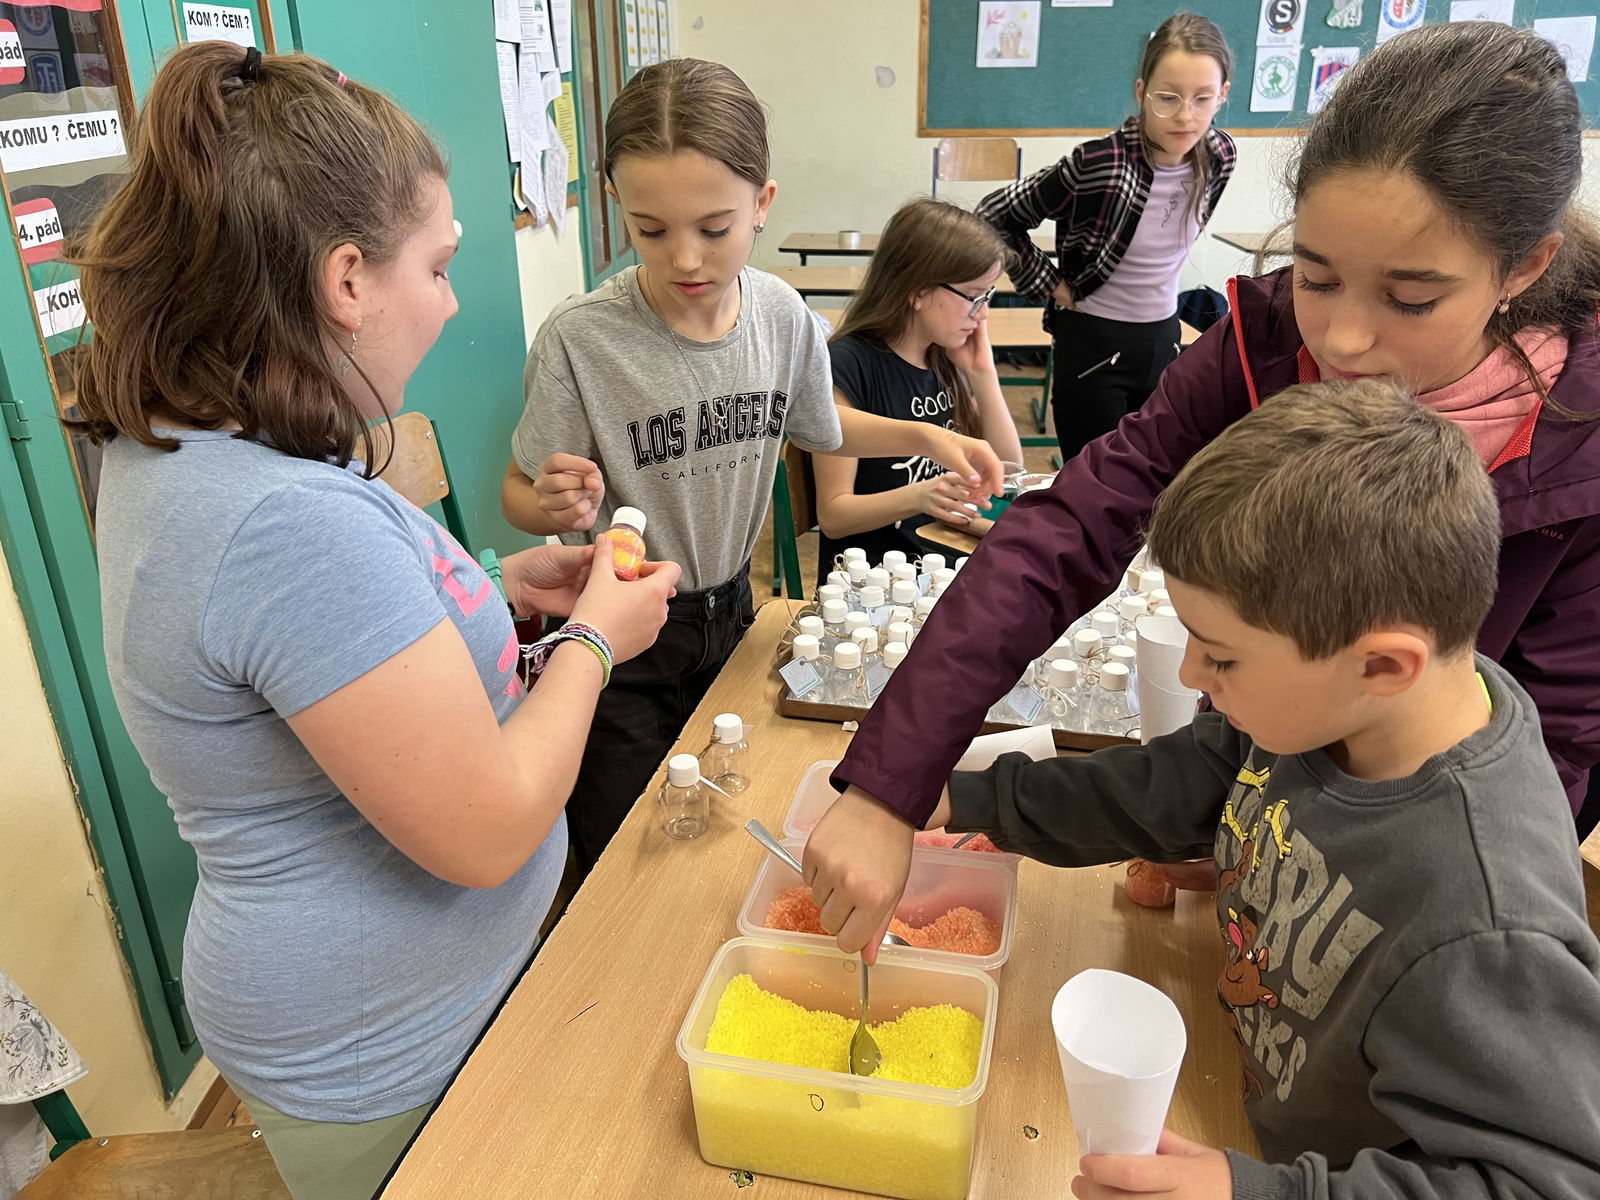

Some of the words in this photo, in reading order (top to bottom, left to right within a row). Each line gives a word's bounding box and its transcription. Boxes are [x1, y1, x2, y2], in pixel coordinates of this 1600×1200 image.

[187, 10, 212, 27] KOM
[221, 10, 243, 29] ČEM
[1275, 0, 1293, 23] S
[0, 125, 49, 149] KOMU
[18, 223, 34, 241] 4.
[35, 216, 61, 242] pád
[46, 288, 81, 313] KOH
[627, 406, 687, 470] LOS
[694, 390, 788, 452] ANGES
[661, 453, 762, 480] CALIFORN
